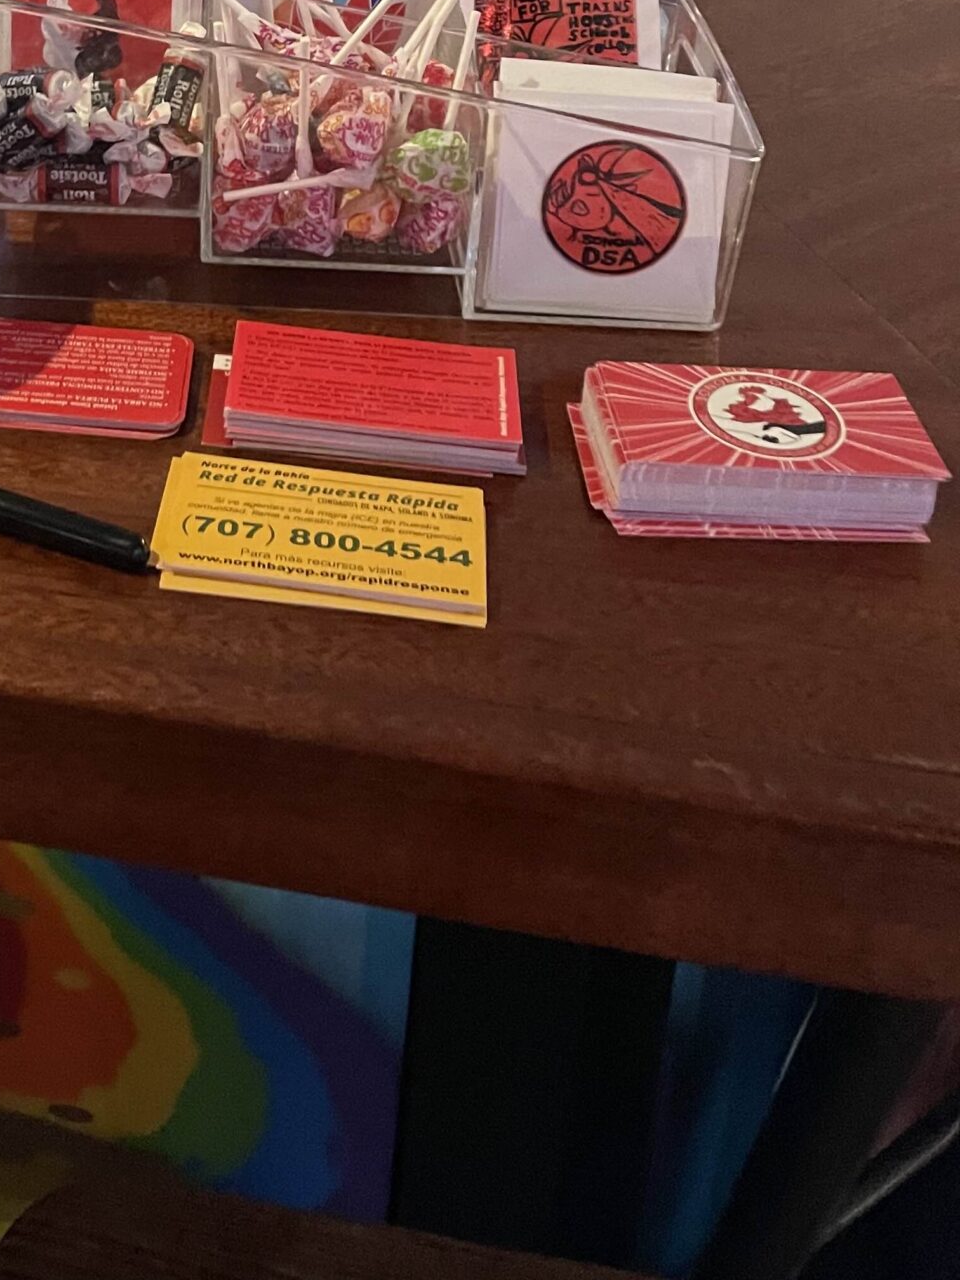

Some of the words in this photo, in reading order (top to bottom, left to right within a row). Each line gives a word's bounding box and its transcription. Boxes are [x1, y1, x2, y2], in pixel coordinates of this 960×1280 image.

[517, 1, 551, 20] FOR
[567, 0, 632, 14] TRAINS
[50, 168, 108, 185] Tootsie
[582, 246, 642, 267] DSA
[199, 470, 238, 483] Red
[243, 475, 267, 488] de
[273, 479, 381, 502] Respuesta
[386, 492, 460, 512] Rápida
[181, 514, 276, 547] (707)
[289, 528, 473, 568] 800-4544
[241, 547, 272, 561] Para
[307, 556, 366, 573] recursos
[178, 551, 470, 597] www.northbayop.org/rapidresponse
